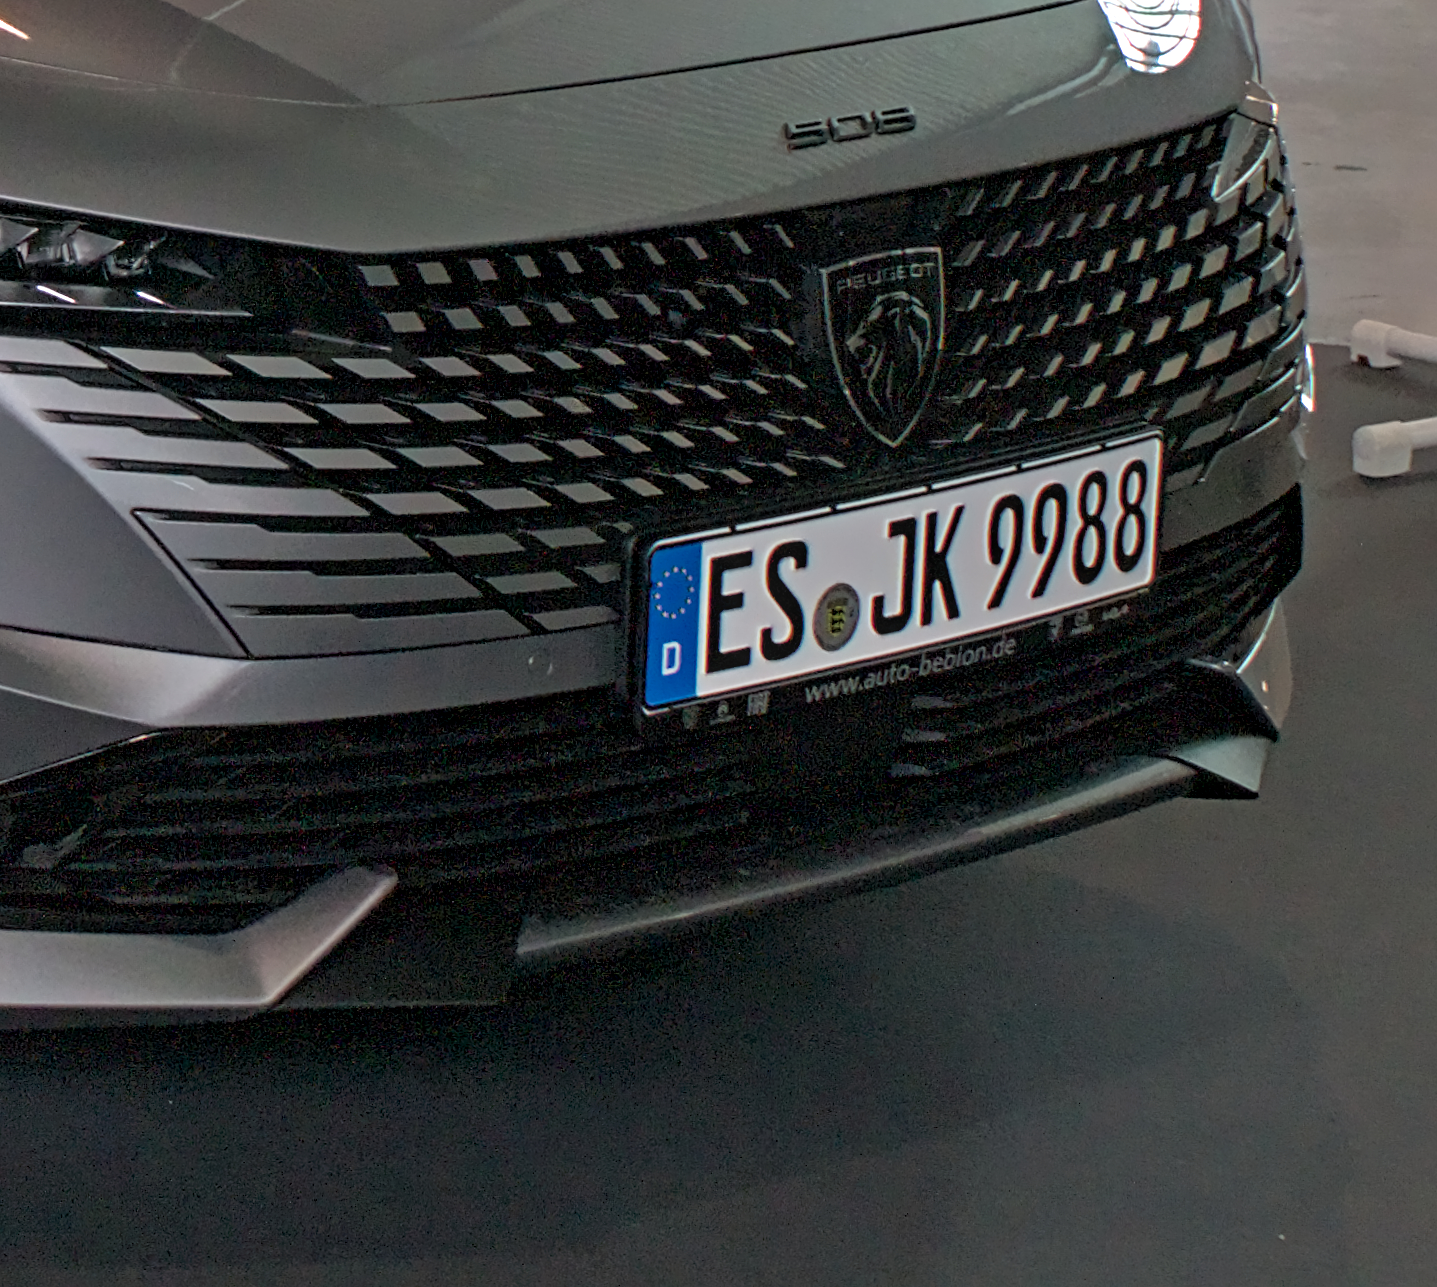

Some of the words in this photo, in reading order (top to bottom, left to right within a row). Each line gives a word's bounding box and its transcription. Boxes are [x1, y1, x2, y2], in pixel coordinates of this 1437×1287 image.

[783, 106, 917, 153] 508
[835, 262, 936, 295] PEUGEOT
[703, 539, 809, 675] ES
[869, 503, 966, 637] JK
[986, 458, 1148, 611] 9988
[660, 640, 683, 676] D
[804, 631, 1017, 704] www.auto-bebion.de
